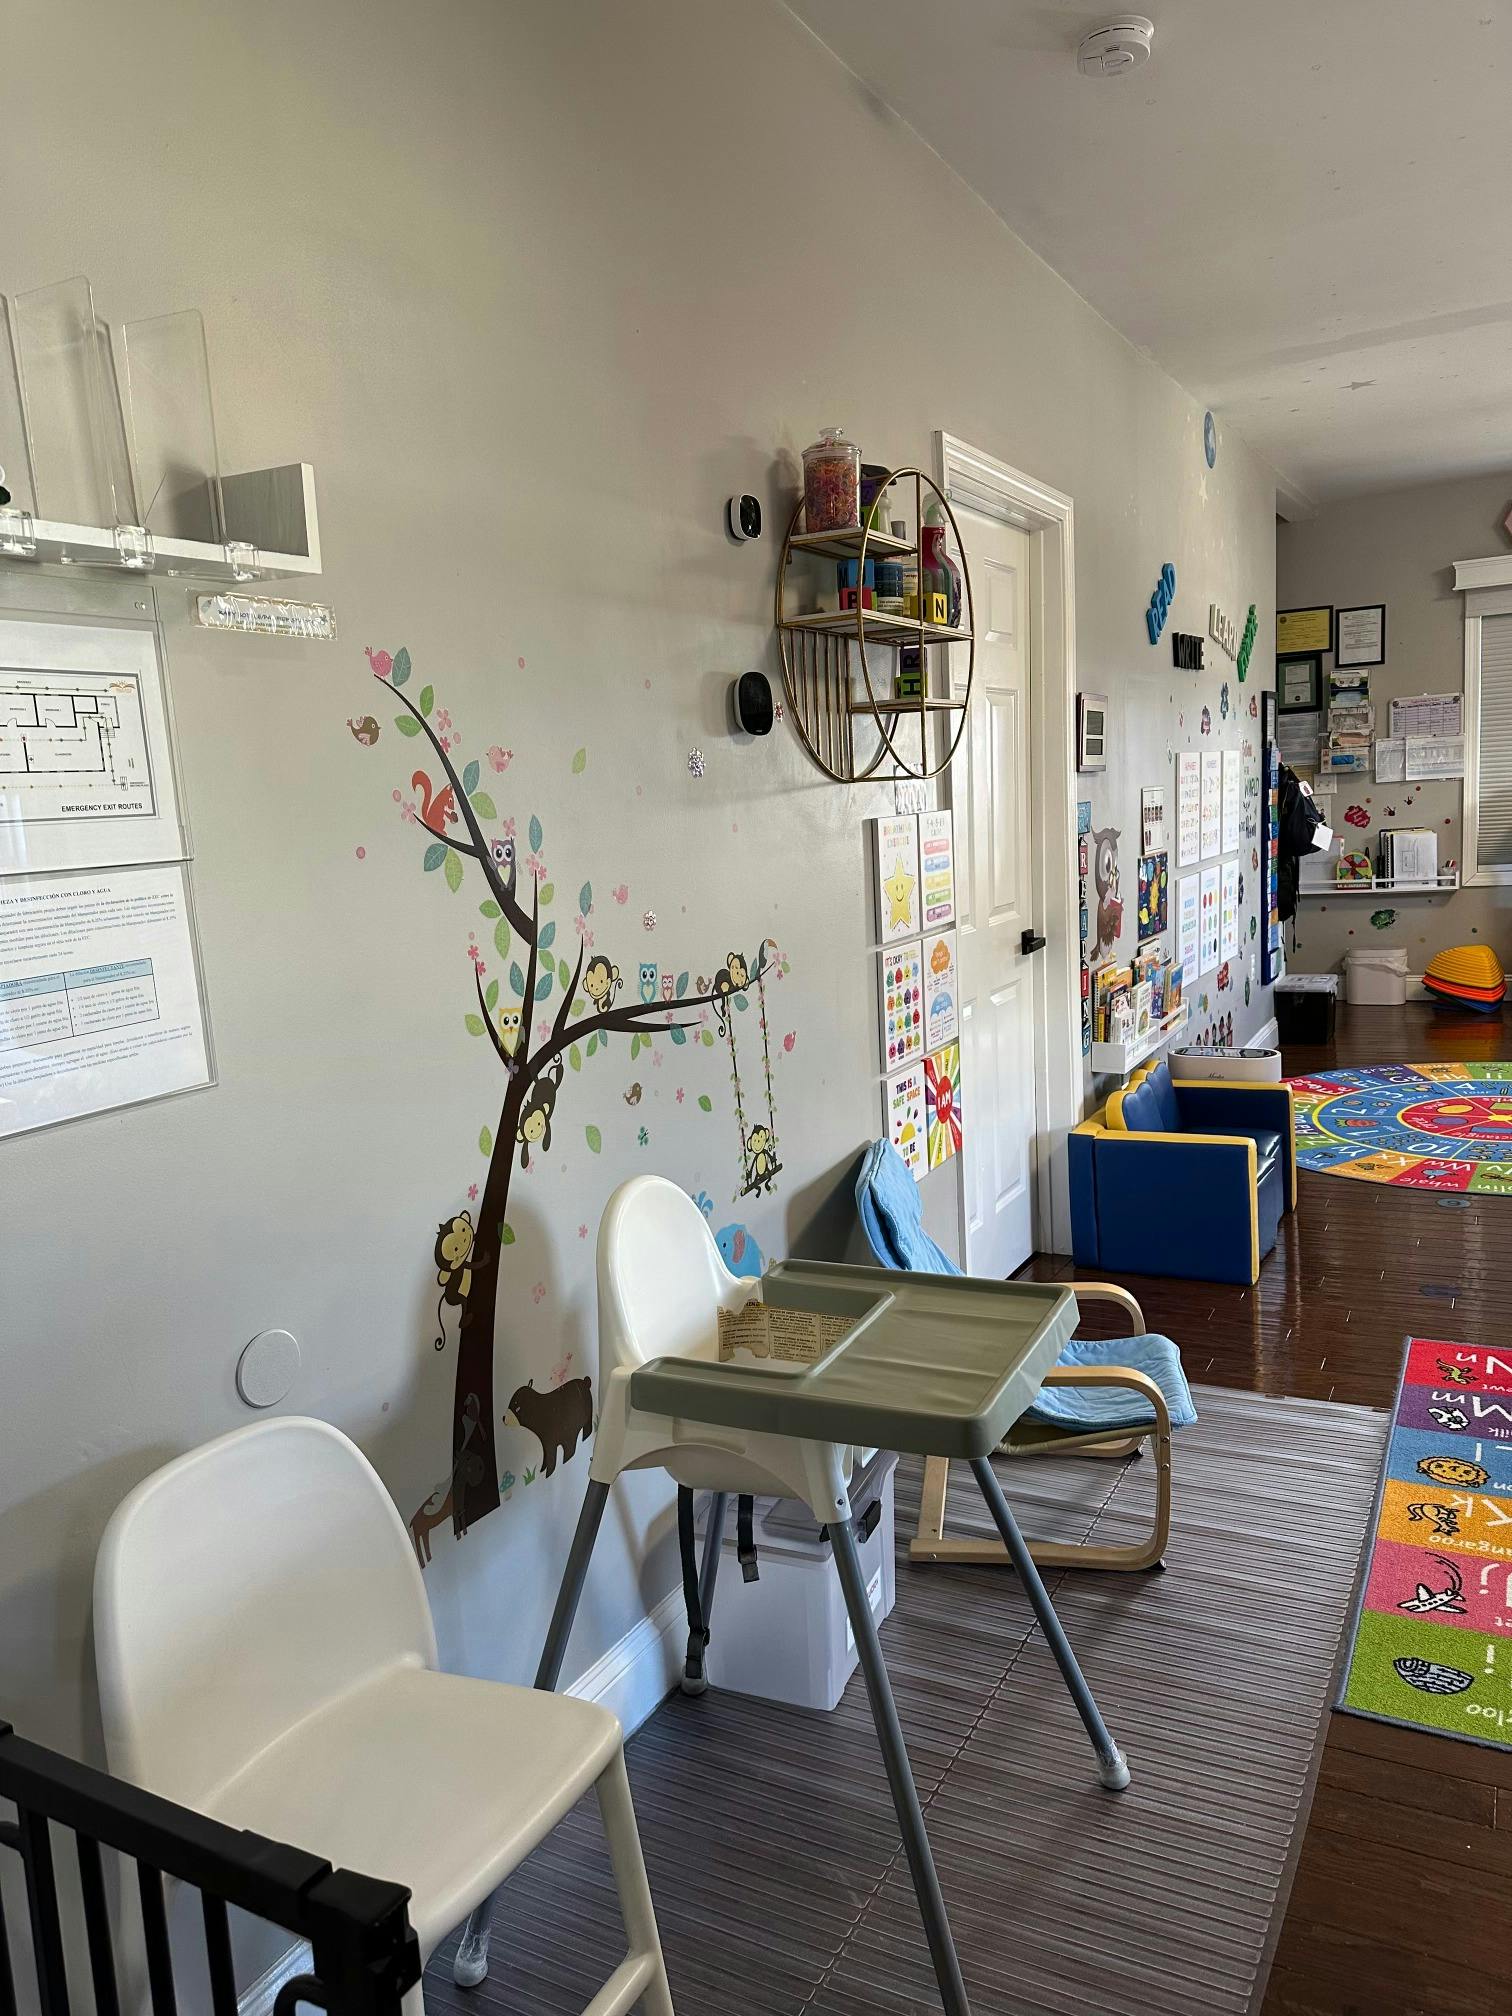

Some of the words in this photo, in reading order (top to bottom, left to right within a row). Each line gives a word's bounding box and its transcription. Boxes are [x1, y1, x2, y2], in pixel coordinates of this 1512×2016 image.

[935, 598, 944, 619] N
[1146, 562, 1176, 645] READ
[1209, 604, 1238, 661] LEARN
[1172, 632, 1204, 670] WRITE
[61, 804, 101, 813] EMERGENCY
[896, 1080, 907, 1095] THIS
[892, 1094, 905, 1109] SAFE
[906, 1086, 921, 1102] SPACE
[941, 1090, 951, 1107] AM
[1332, 1107, 1367, 1115] 2
[1407, 1142, 1453, 1154] 10
[1400, 1178, 1459, 1188] whale
[1488, 1427, 1512, 1438] ilk
[1429, 1535, 1512, 1555] angaroo
